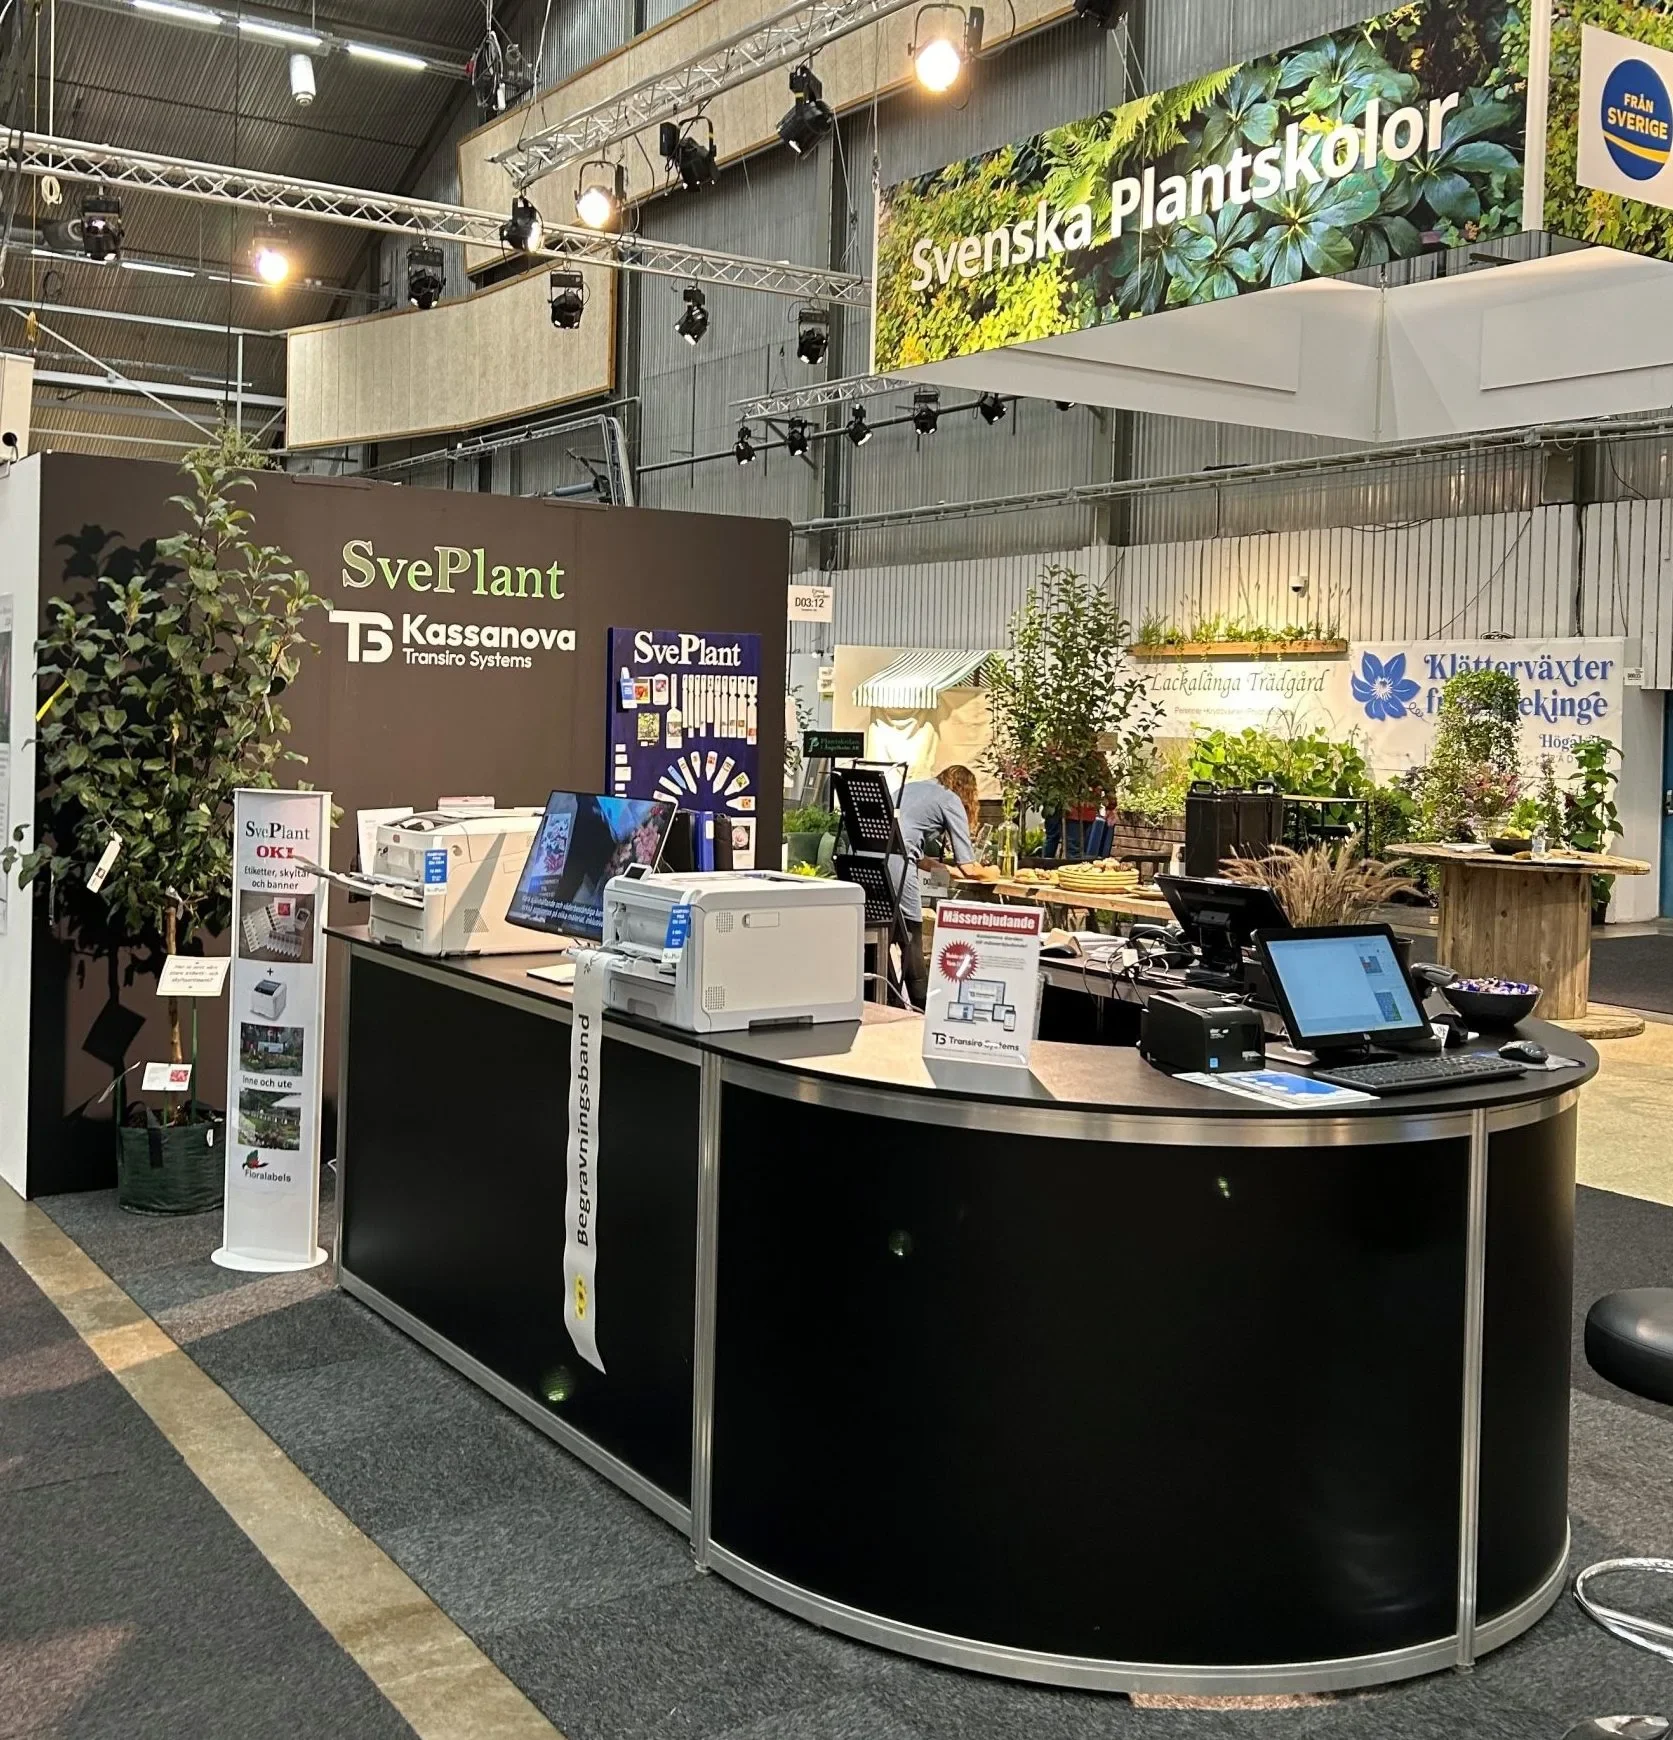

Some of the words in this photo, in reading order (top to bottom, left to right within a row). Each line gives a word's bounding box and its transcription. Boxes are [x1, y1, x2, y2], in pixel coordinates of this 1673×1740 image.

[1624, 92, 1655, 114] FRÅN
[1607, 107, 1669, 140] SVERIGE
[910, 197, 1093, 293] Svenska
[1111, 90, 1461, 238] Plantskolor
[341, 539, 565, 600] SvePlant
[795, 597, 825, 608] D03:12
[402, 613, 576, 651] Kassanova
[402, 648, 466, 667] Transiro
[469, 651, 532, 671] Systems
[634, 631, 742, 667] SvePlant
[1423, 652, 1614, 687] Klätterväxter
[1150, 669, 1241, 698] Lackalånga
[1247, 668, 1330, 699] Trädgård
[1519, 687, 1609, 725] ekinge
[245, 820, 310, 841] SvePlant
[244, 865, 278, 878] Etiketter,
[252, 879, 265, 888] och
[266, 880, 299, 890] banner
[942, 910, 1036, 930] Mässerbjudande
[948, 1036, 983, 1047] Transiro
[242, 1074, 259, 1086] Inne
[260, 1076, 275, 1088] och
[277, 1078, 292, 1089] ute
[576, 1011, 591, 1248] Begravningsband
[244, 1169, 292, 1183] Floralabels
